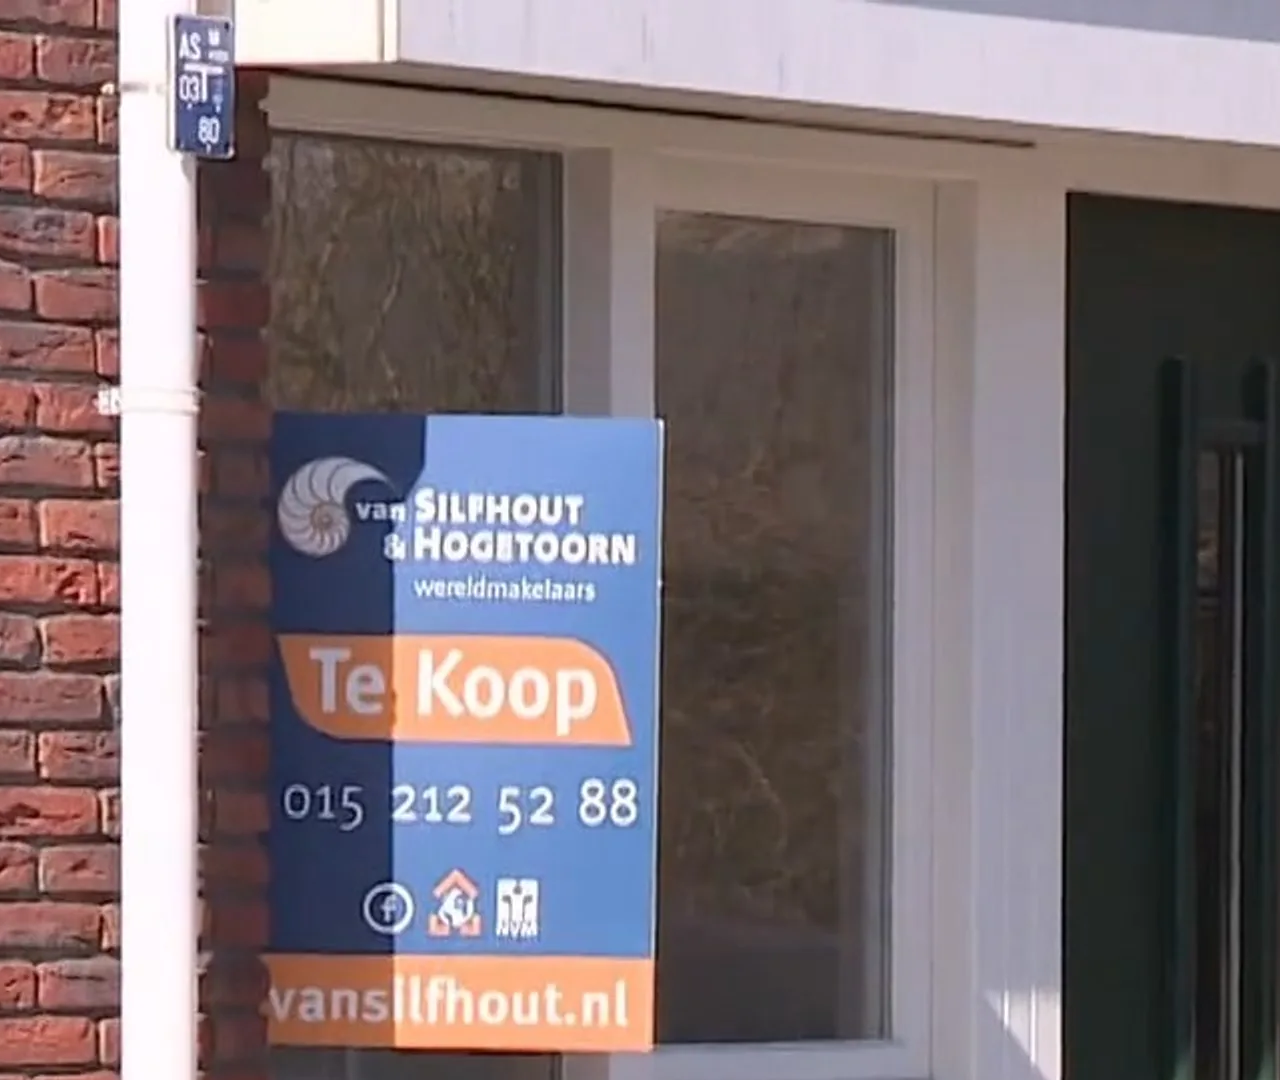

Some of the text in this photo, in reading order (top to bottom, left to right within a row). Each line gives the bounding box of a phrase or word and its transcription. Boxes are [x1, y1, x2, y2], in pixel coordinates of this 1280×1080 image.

[179, 31, 202, 60] AS
[356, 488, 584, 525] van SILFHOUT
[384, 534, 405, 561] &
[414, 576, 596, 602] wereldmakelaars
[309, 647, 598, 737] Te Koop
[283, 778, 638, 835] 015 212 52 88
[269, 972, 629, 1030] vansilfhout.nl
